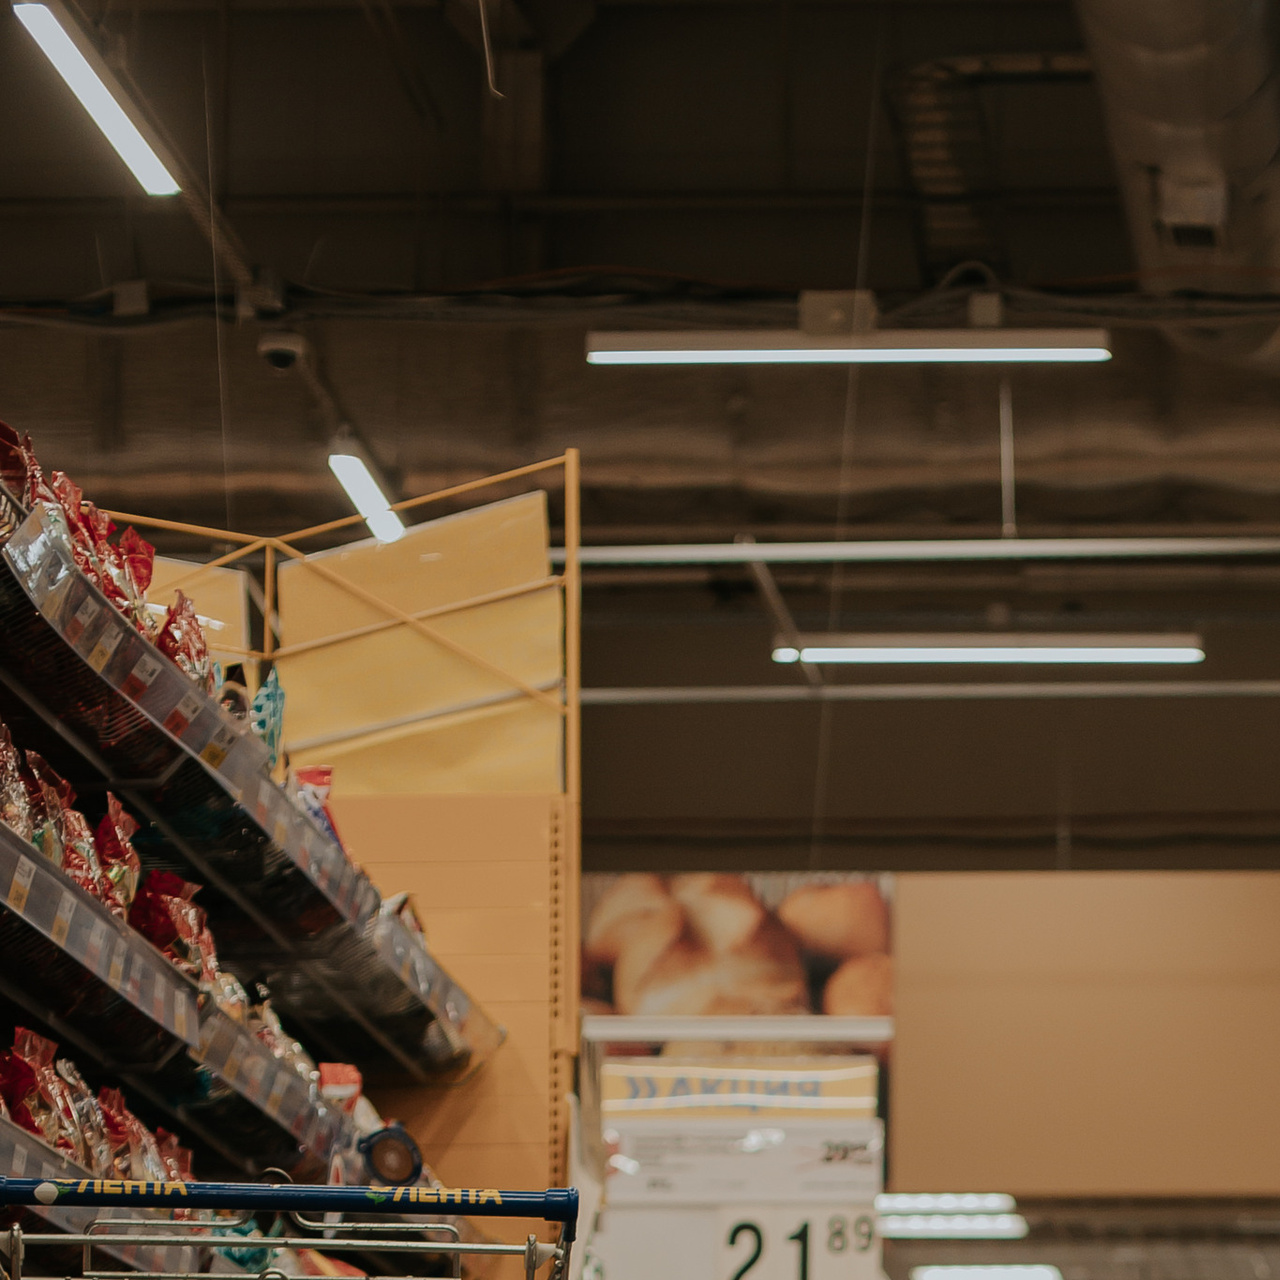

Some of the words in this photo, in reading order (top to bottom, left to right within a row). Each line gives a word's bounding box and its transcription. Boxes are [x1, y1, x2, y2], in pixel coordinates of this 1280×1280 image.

[667, 1075, 822, 1112] АКЦИЯ
[77, 1179, 187, 1196] ЛЕНТА
[392, 1187, 503, 1205] ЛЕНТА
[827, 1215, 873, 1252] 89
